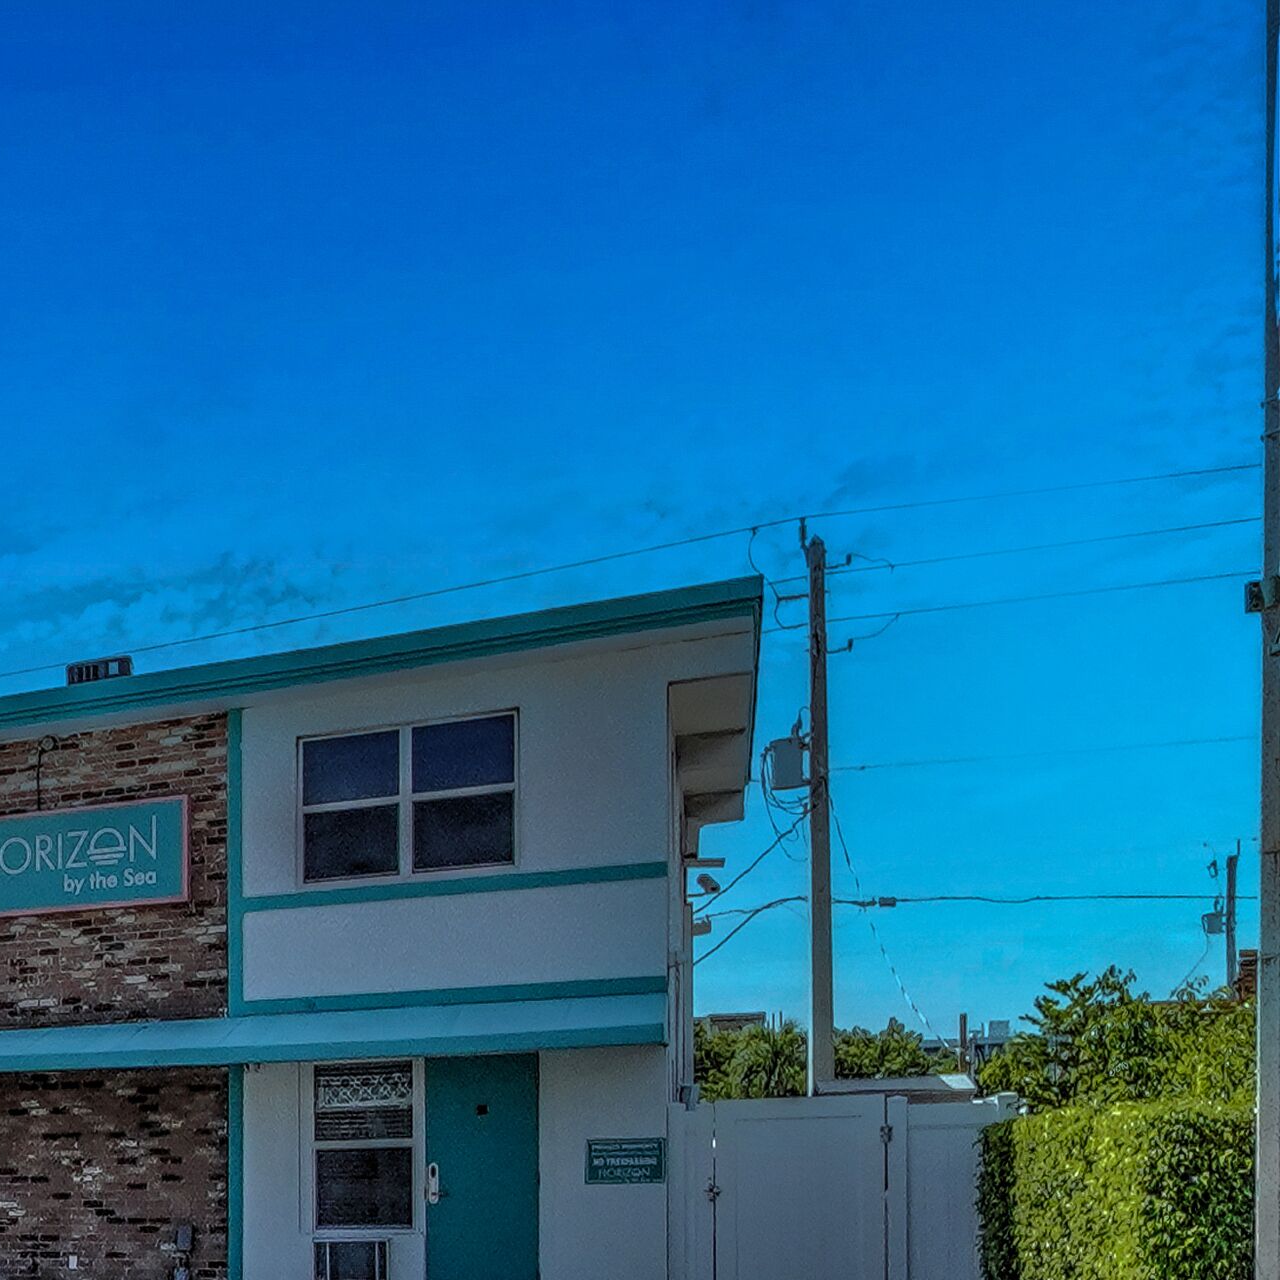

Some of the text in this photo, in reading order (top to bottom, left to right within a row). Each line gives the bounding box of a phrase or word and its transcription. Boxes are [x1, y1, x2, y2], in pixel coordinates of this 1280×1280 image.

[64, 868, 157, 895] by the Sea
